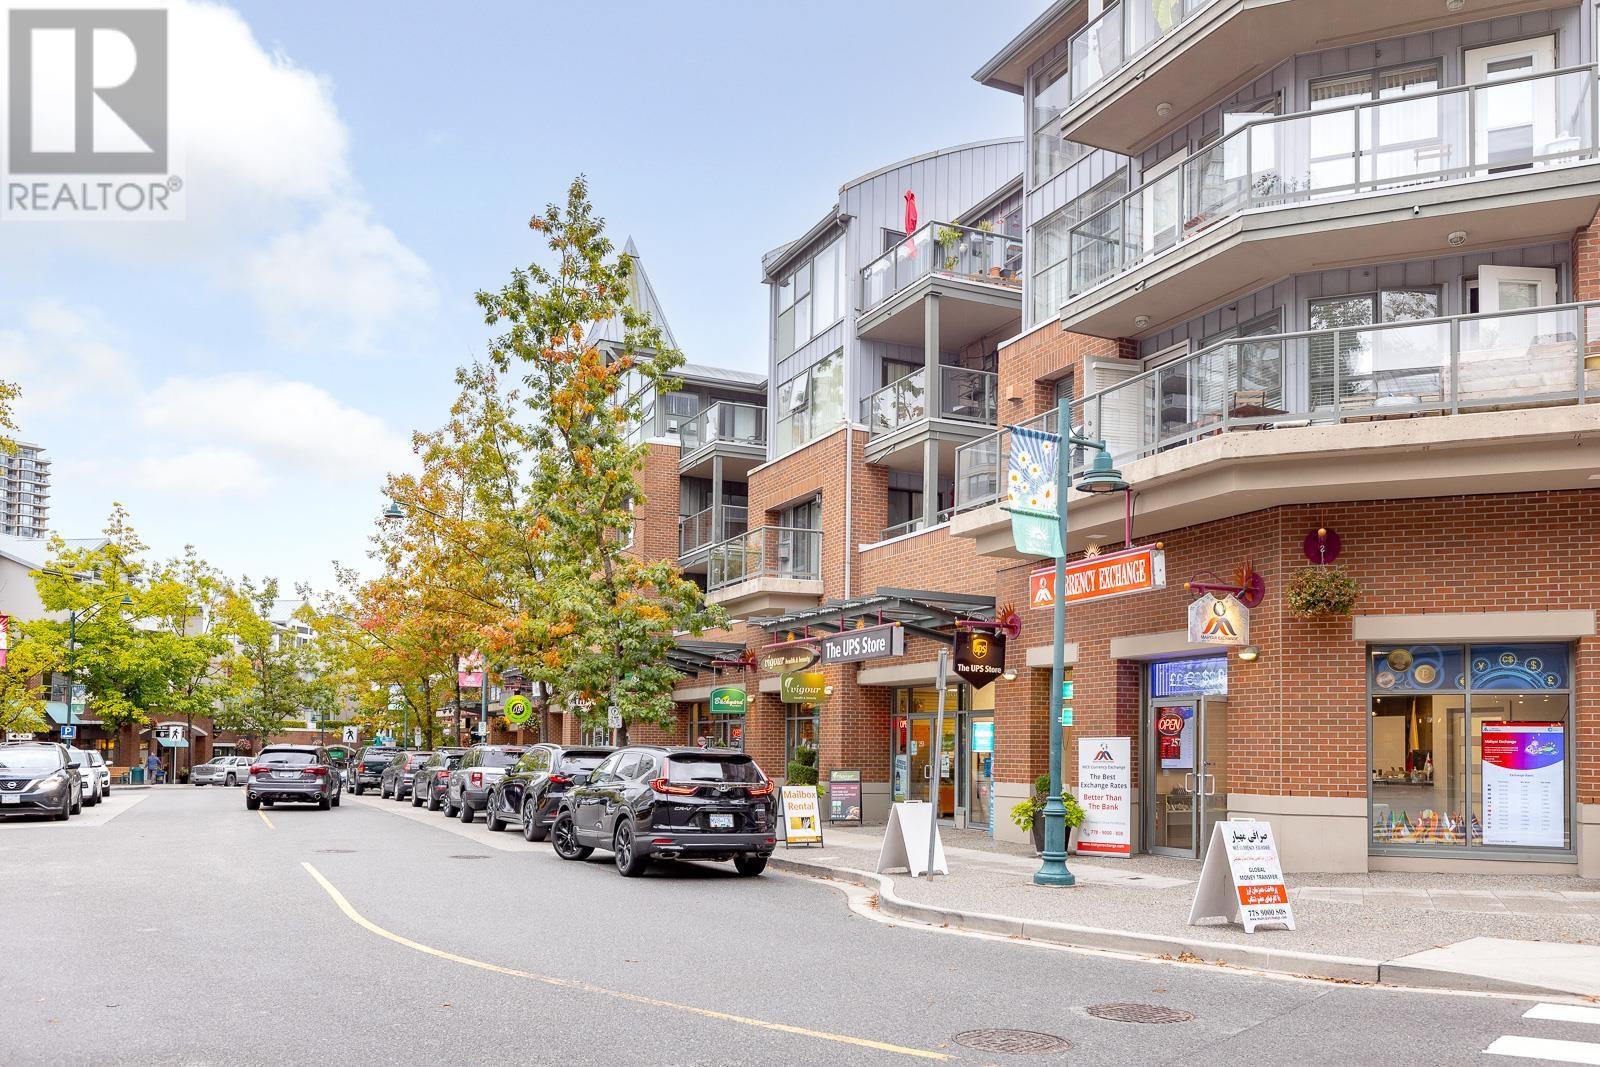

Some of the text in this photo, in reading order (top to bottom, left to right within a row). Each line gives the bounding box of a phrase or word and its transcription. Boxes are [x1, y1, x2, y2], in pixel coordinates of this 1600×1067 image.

[1099, 559, 1146, 590] EXCHANGE
[826, 636, 886, 659] The UPS Store
[764, 654, 785, 670] vigour
[970, 664, 984, 672] UPS
[791, 684, 821, 694] vigour
[1160, 720, 1180, 730] OPEN
[784, 791, 816, 799] Mailbox
